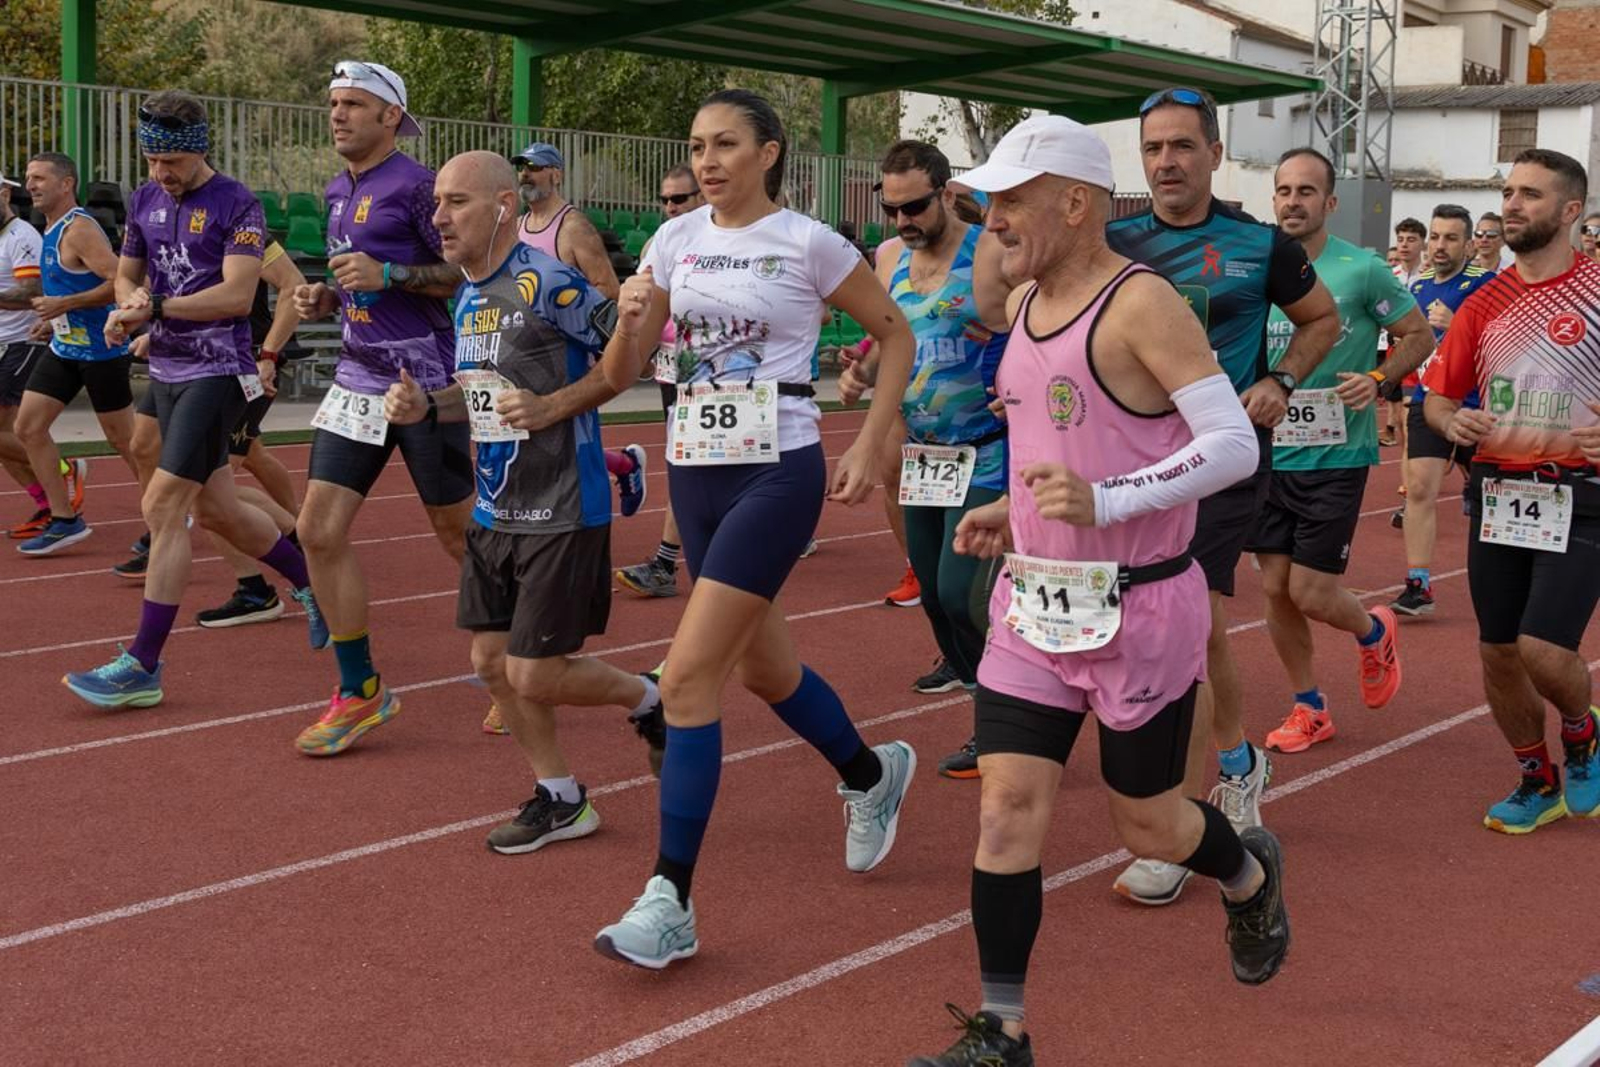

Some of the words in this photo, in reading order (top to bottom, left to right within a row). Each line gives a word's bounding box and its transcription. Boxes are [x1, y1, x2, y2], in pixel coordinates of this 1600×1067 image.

[682, 253, 698, 265] 26
[693, 259, 751, 270] PUENTES
[474, 307, 501, 334] SOY
[471, 389, 494, 413] 82
[699, 403, 738, 430] 58
[1287, 405, 1316, 423] 96
[917, 462, 956, 481] 112
[513, 507, 553, 522] DIABLO
[1508, 498, 1541, 520] 14
[1036, 584, 1071, 614] 11
